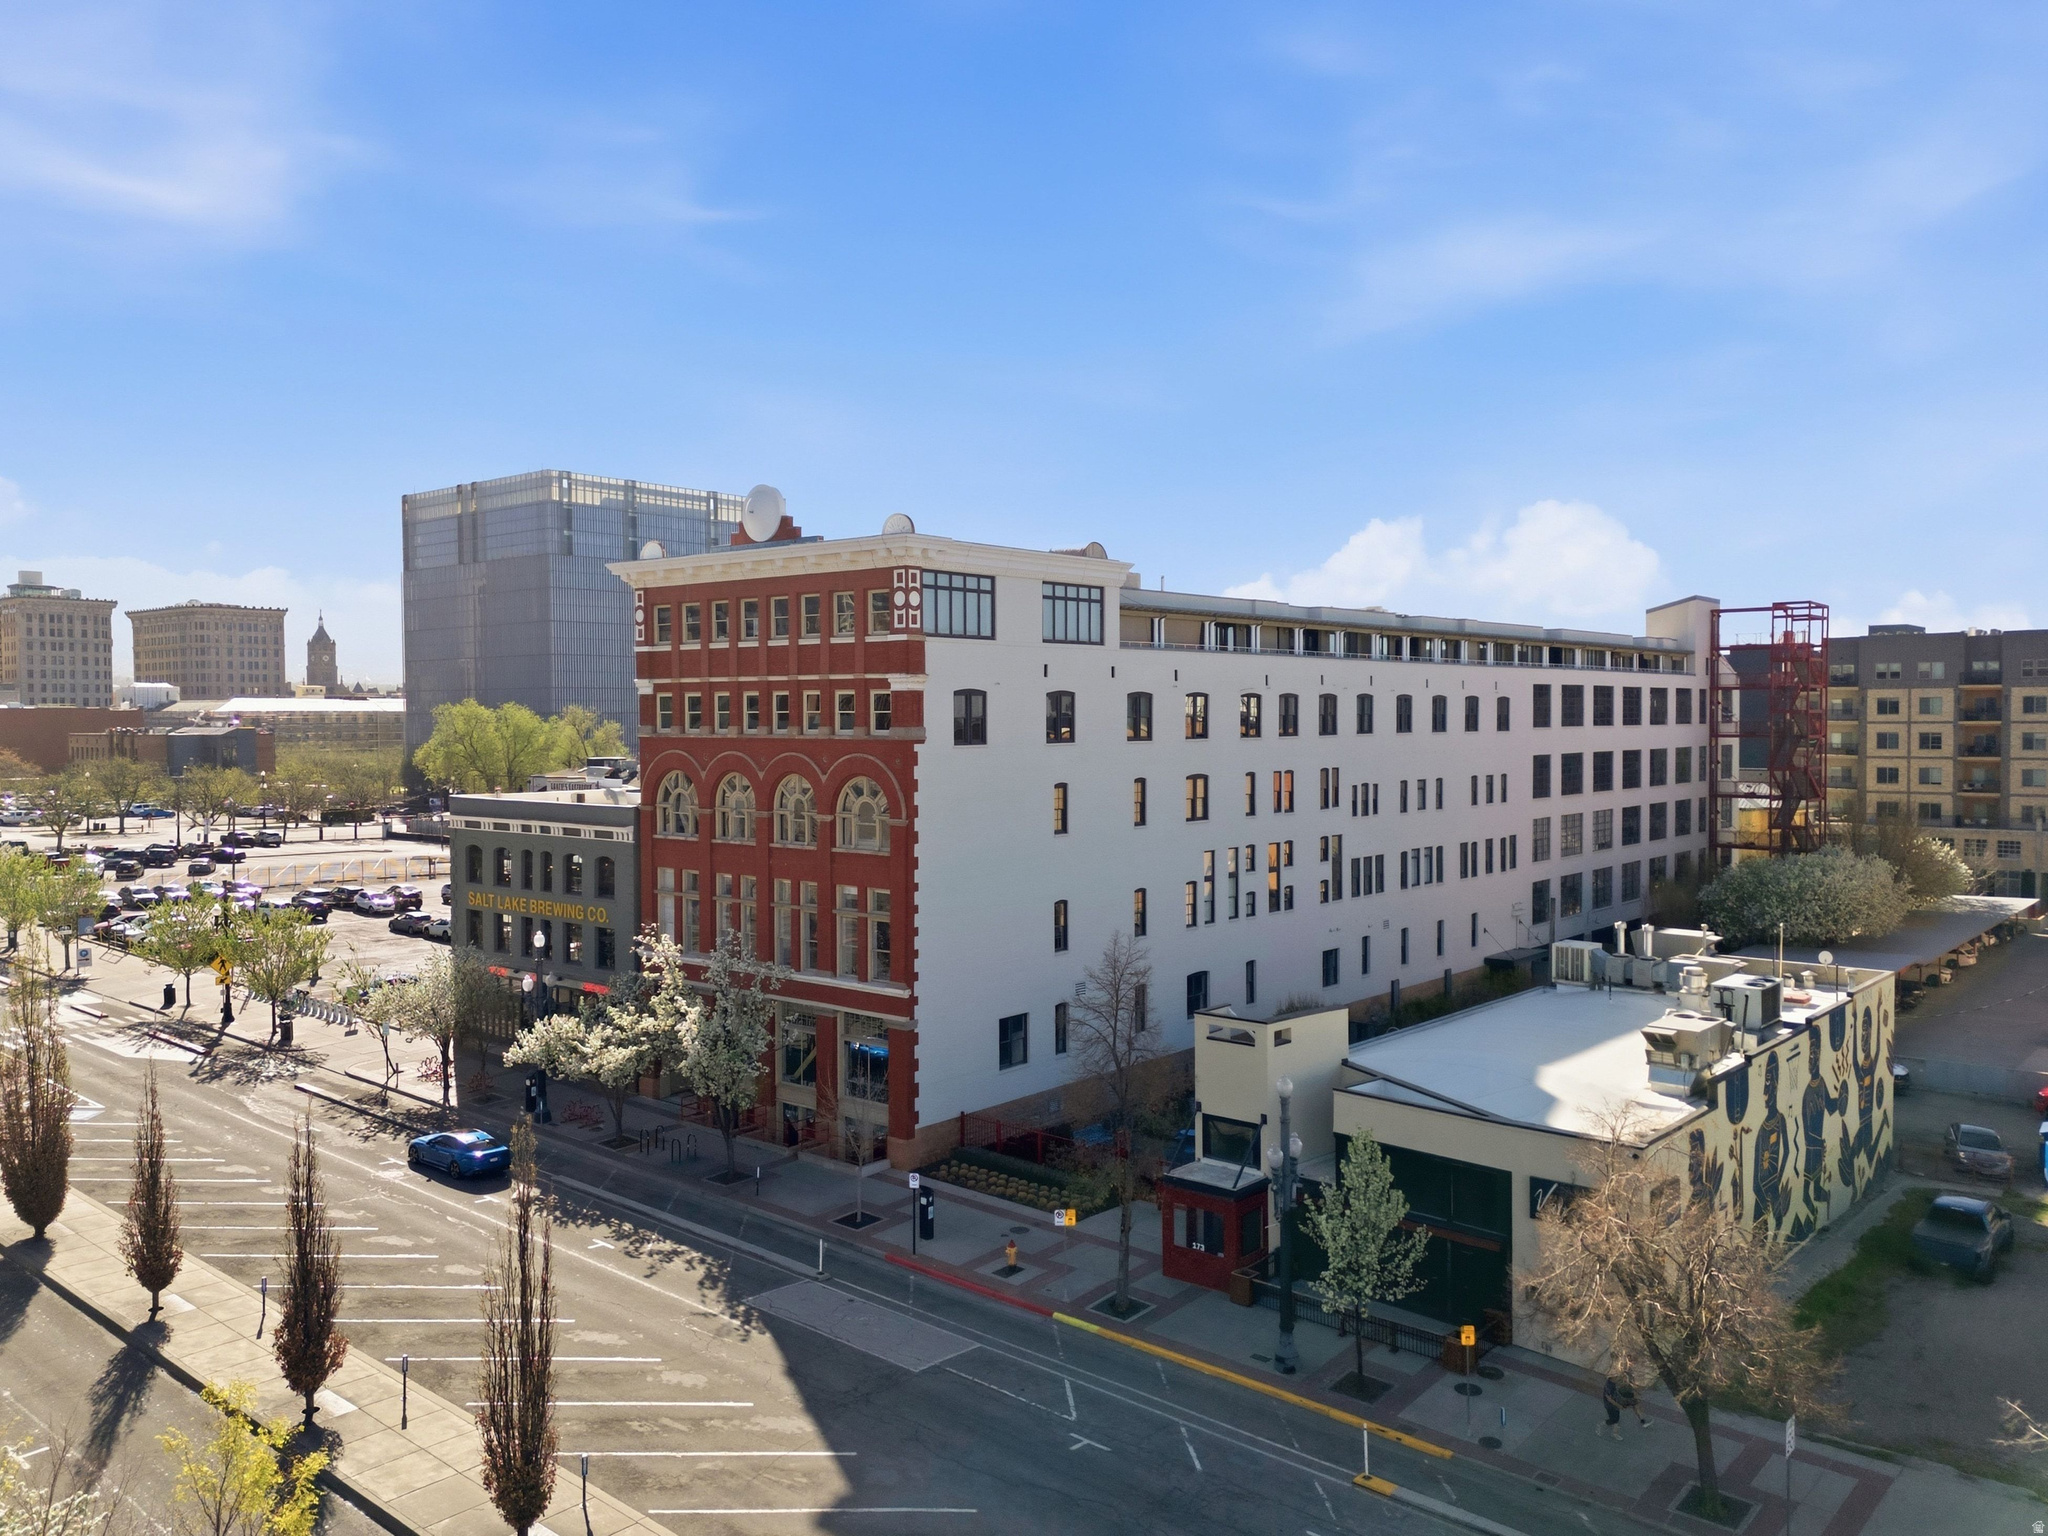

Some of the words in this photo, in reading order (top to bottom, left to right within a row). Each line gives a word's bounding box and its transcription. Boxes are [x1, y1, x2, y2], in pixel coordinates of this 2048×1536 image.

[468, 891, 494, 907] SALT
[497, 895, 527, 912] LAKE
[530, 899, 584, 920] BREWING
[587, 906, 609, 923] CO.
[1192, 1242, 1205, 1252] 173
